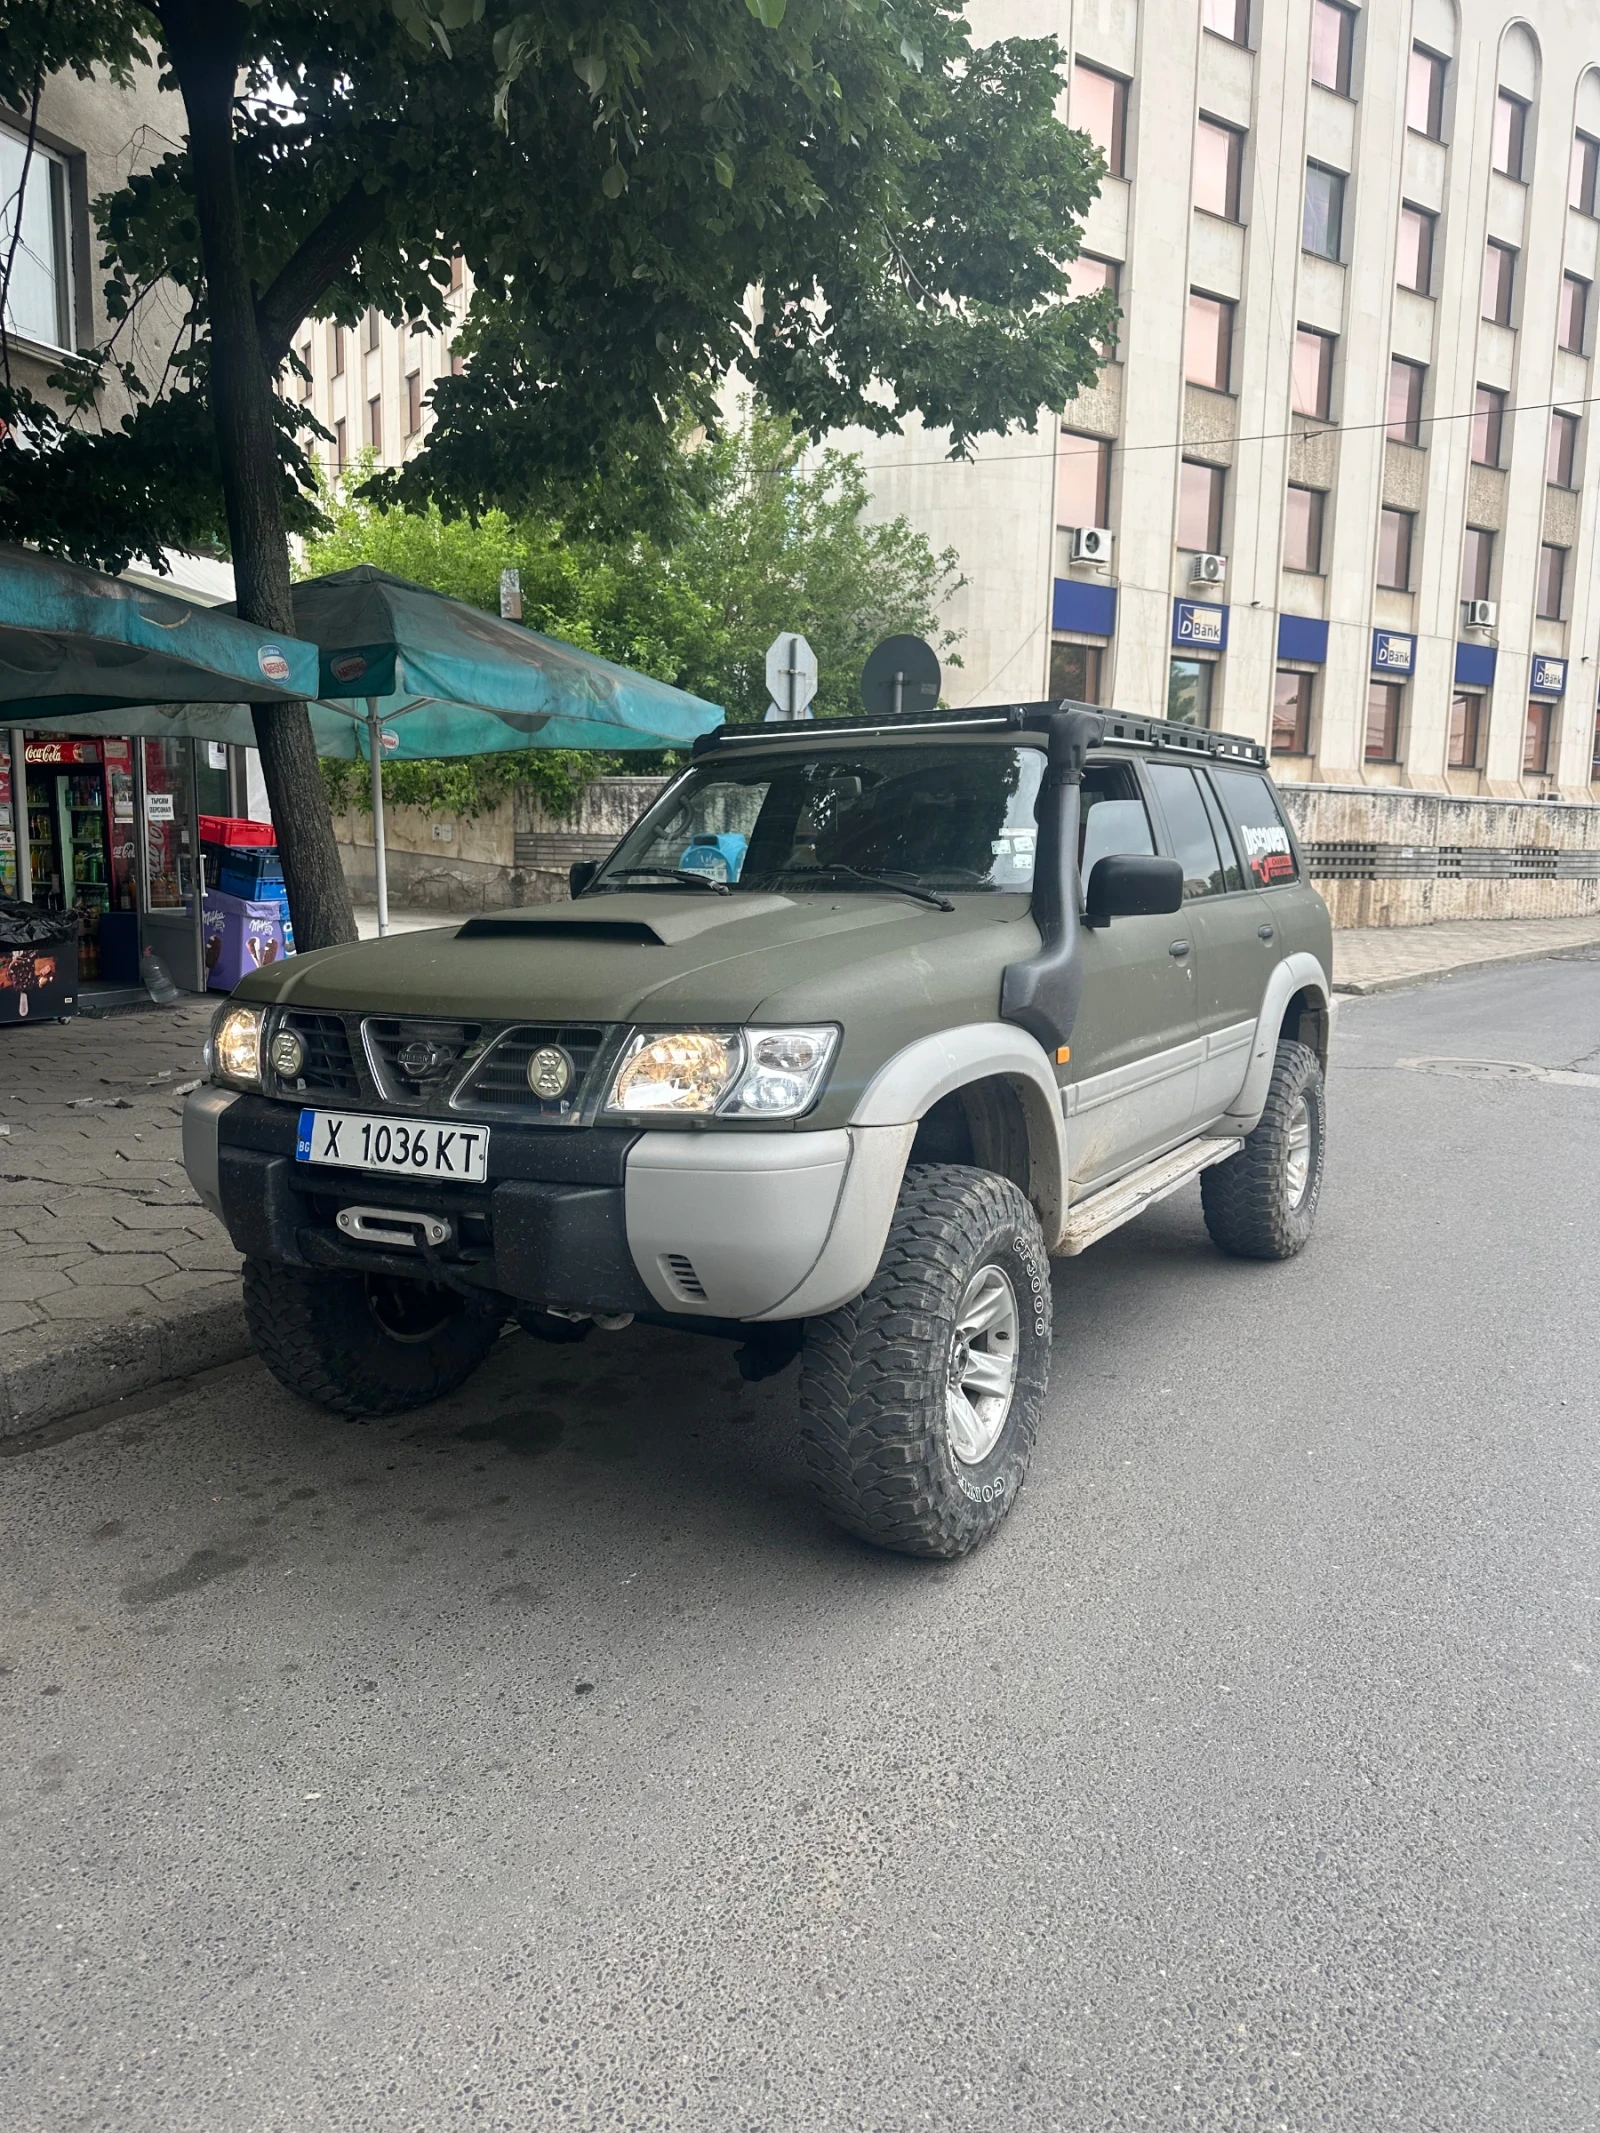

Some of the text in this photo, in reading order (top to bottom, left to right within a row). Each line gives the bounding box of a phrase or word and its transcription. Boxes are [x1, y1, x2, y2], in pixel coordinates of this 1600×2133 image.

[299, 1141, 310, 1153] BG
[324, 1119, 343, 1158] X
[1012, 1236, 1045, 1337] CF3000
